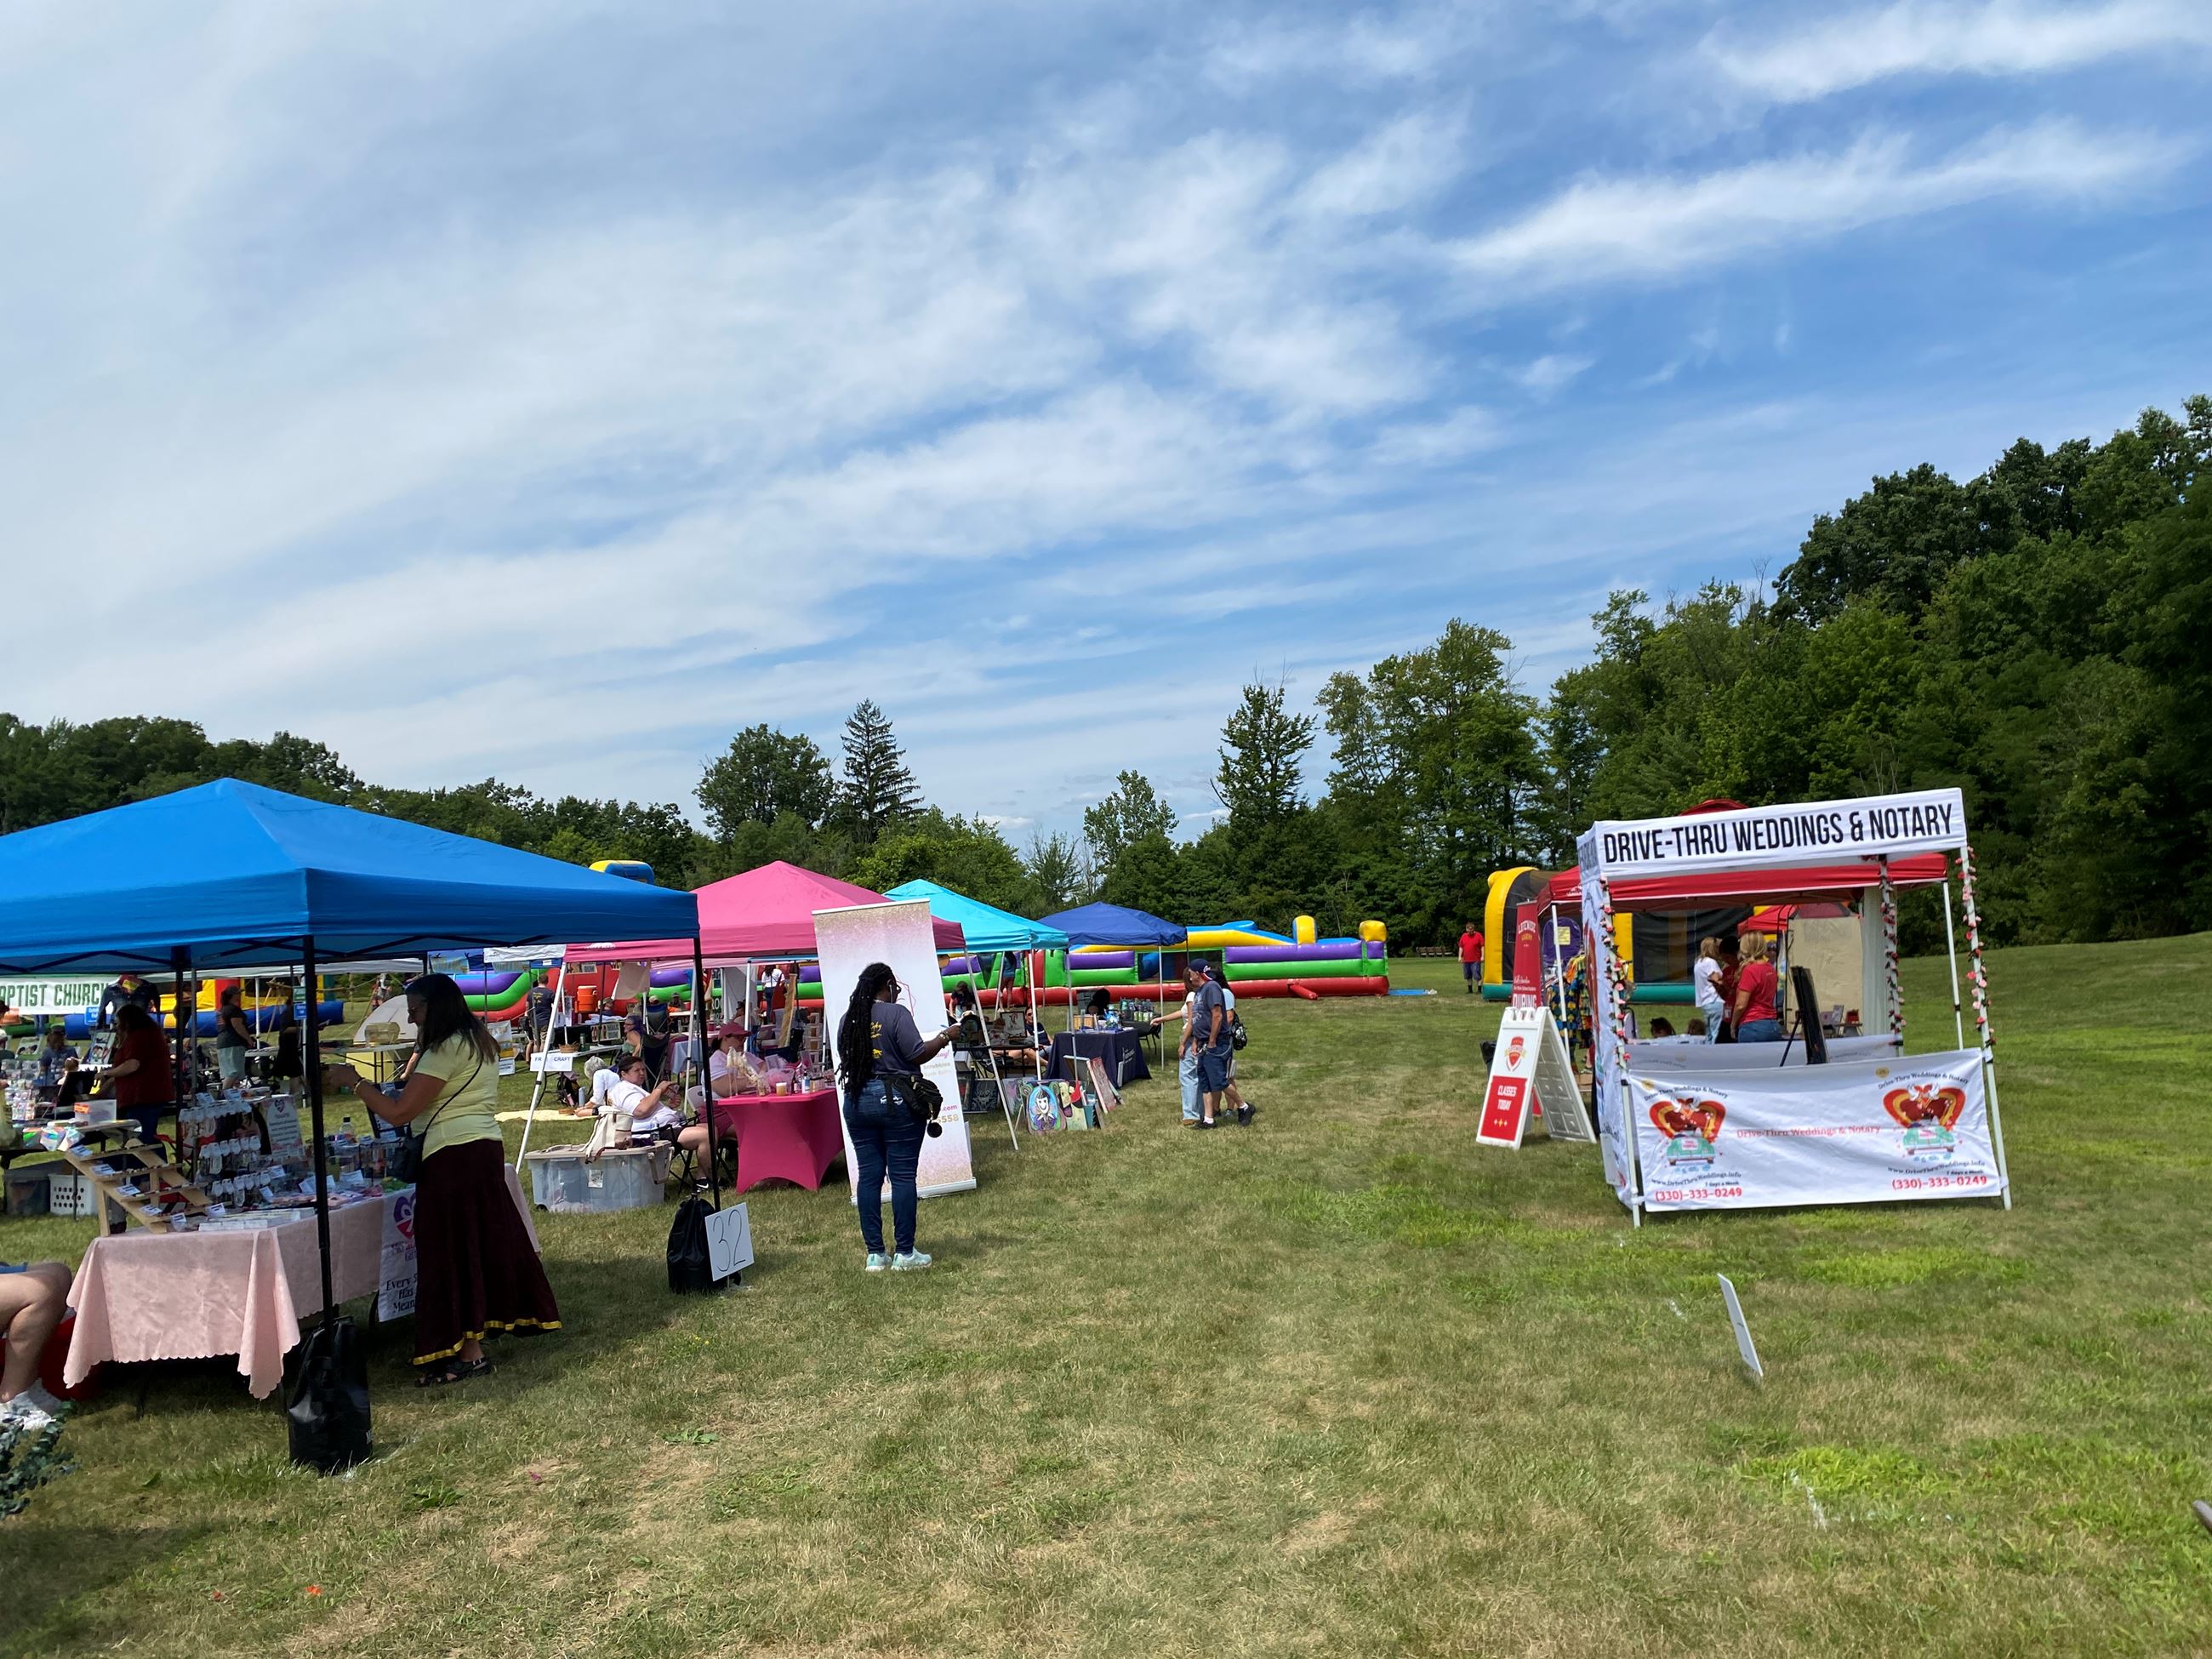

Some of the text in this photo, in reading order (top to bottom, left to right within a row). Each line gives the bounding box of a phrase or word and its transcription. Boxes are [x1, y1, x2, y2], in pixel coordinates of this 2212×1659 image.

[1604, 824, 1728, 863] DRIVE-THRU
[1731, 812, 1844, 852] WEDDINGS
[1849, 811, 1863, 841] &
[1869, 803, 1952, 841] NOTARY
[54, 983, 109, 1006] CHURC
[1497, 1085, 1518, 1097] CLASSES
[1791, 1126, 1835, 1137] Weddings
[1848, 1124, 1881, 1135] Notary
[1892, 1176, 1987, 1190] (330)-333-0249
[1655, 1187, 1743, 1202] (330)-333-0249
[713, 1209, 746, 1272] 32
[386, 1278, 410, 1291] Every
[392, 1298, 415, 1313] Mean
